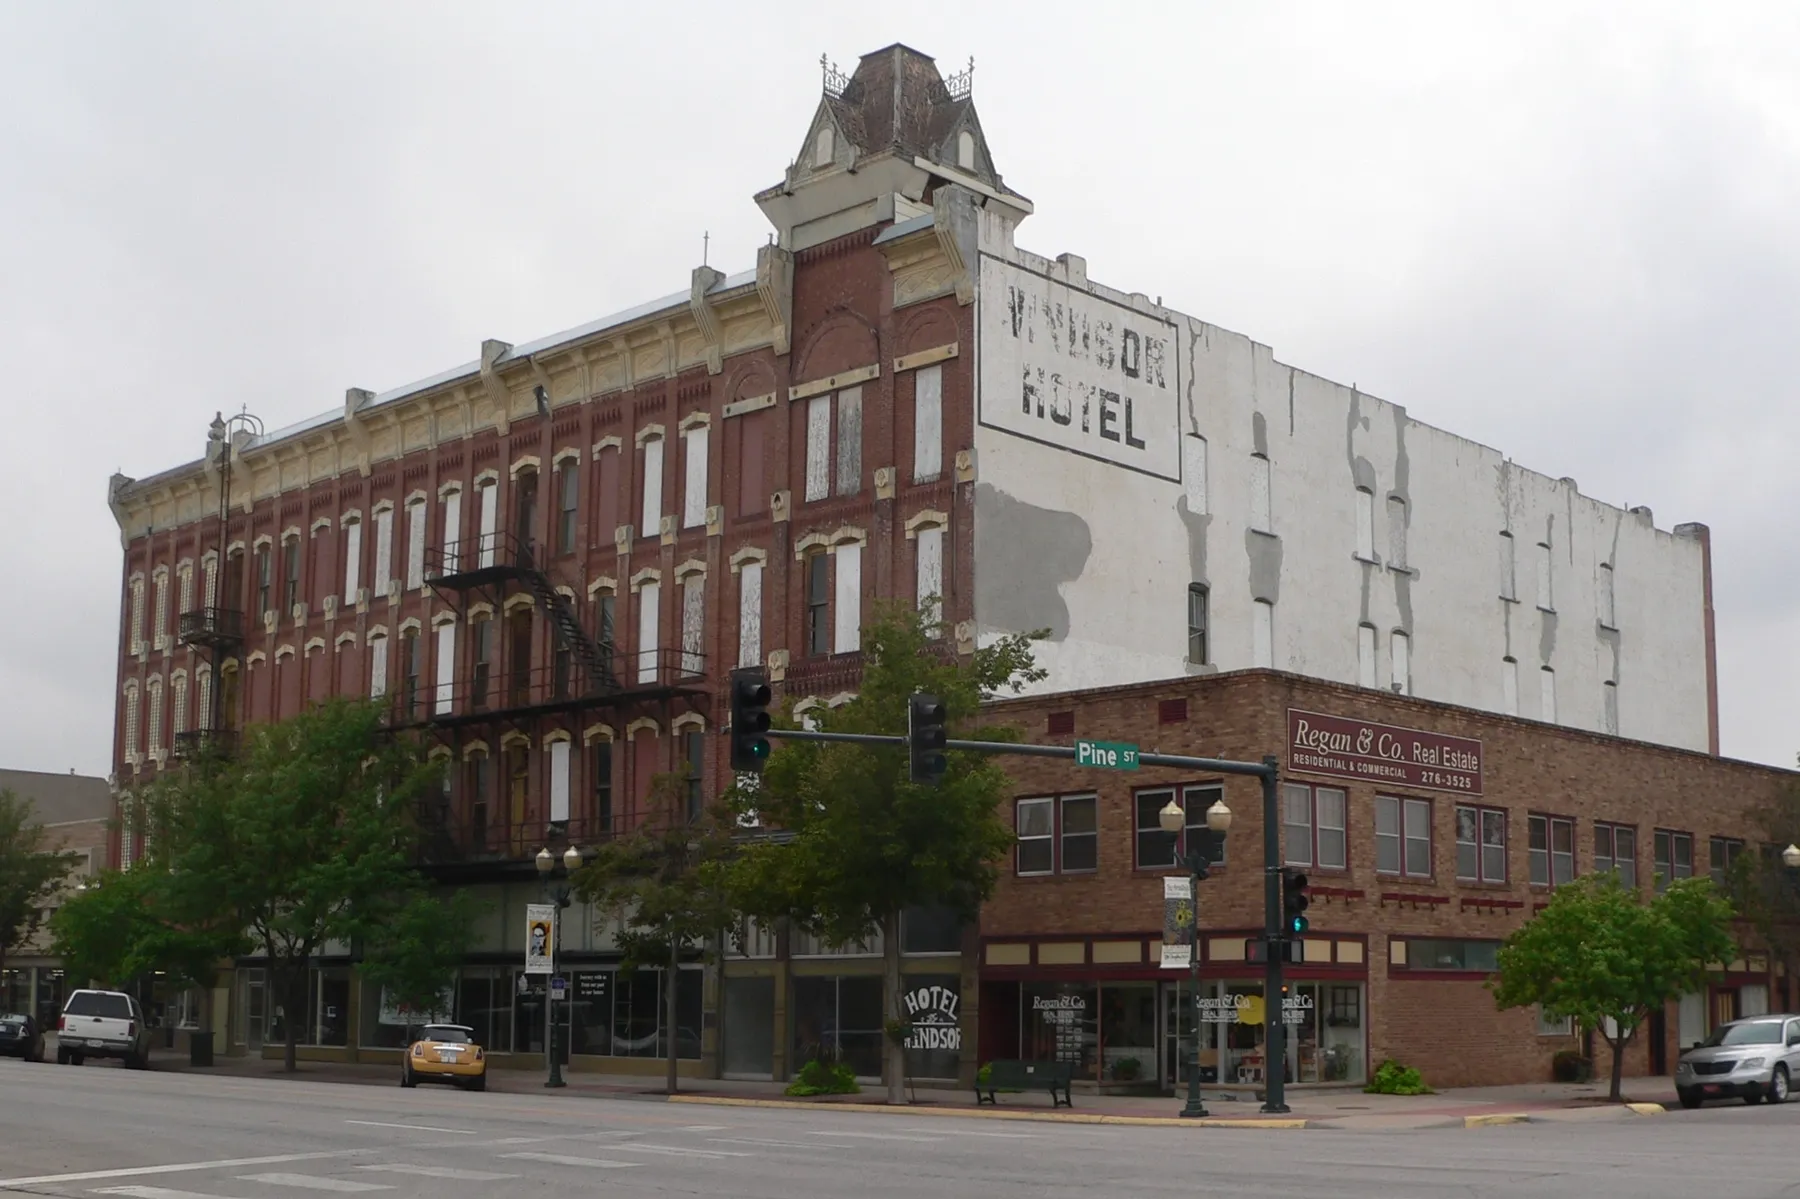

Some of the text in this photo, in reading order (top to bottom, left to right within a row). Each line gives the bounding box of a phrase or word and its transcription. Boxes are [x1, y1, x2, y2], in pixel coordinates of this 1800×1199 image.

[1022, 362, 1146, 450] HOTEL
[1078, 742, 1135, 766] Pine ST
[1294, 719, 1478, 771] Regan & Co. Real Estate
[1293, 753, 1472, 788] RESIDENTIAL & COMMERCIAL 276-3525
[904, 986, 958, 1021] HOTEL
